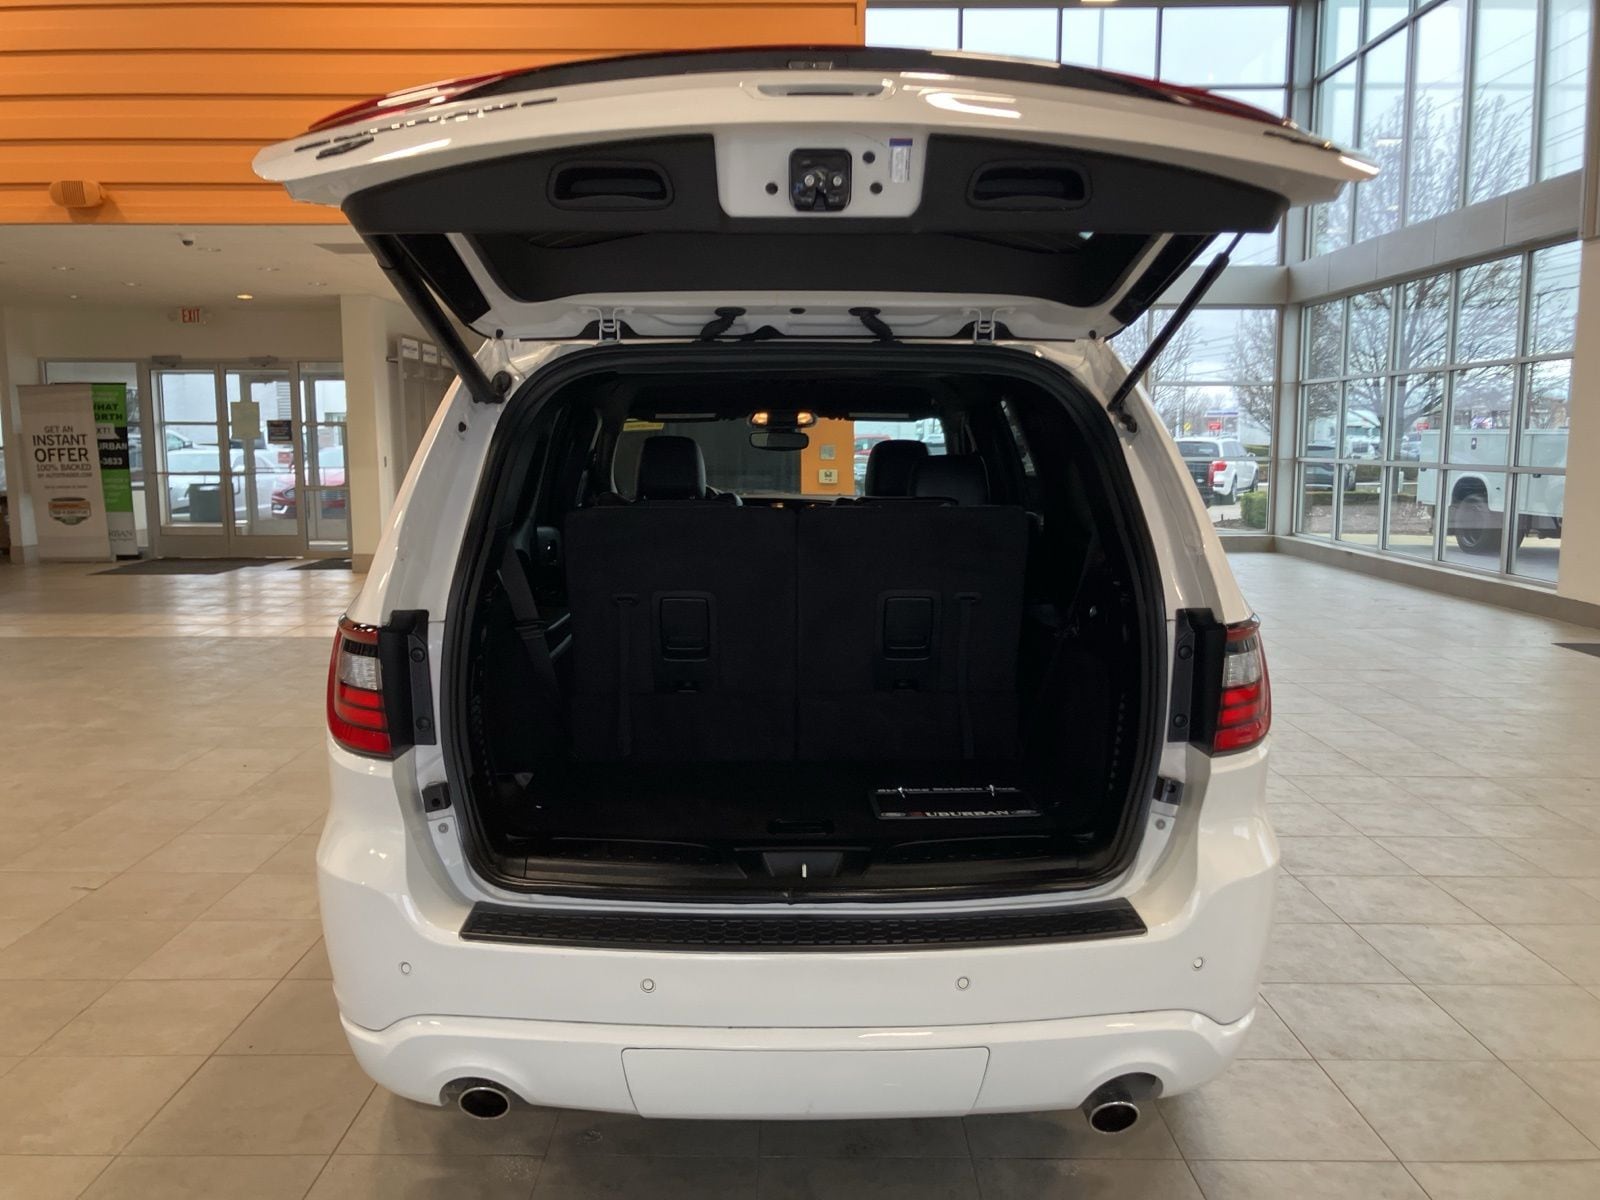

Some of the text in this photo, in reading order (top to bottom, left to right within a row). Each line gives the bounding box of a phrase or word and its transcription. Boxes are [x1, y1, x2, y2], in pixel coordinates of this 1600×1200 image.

[182, 309, 200, 323] EXIT
[44, 425, 73, 433] GET AN
[32, 434, 88, 446] INSTANT
[34, 447, 89, 462] OFFER
[60, 463, 92, 471] BACKED
